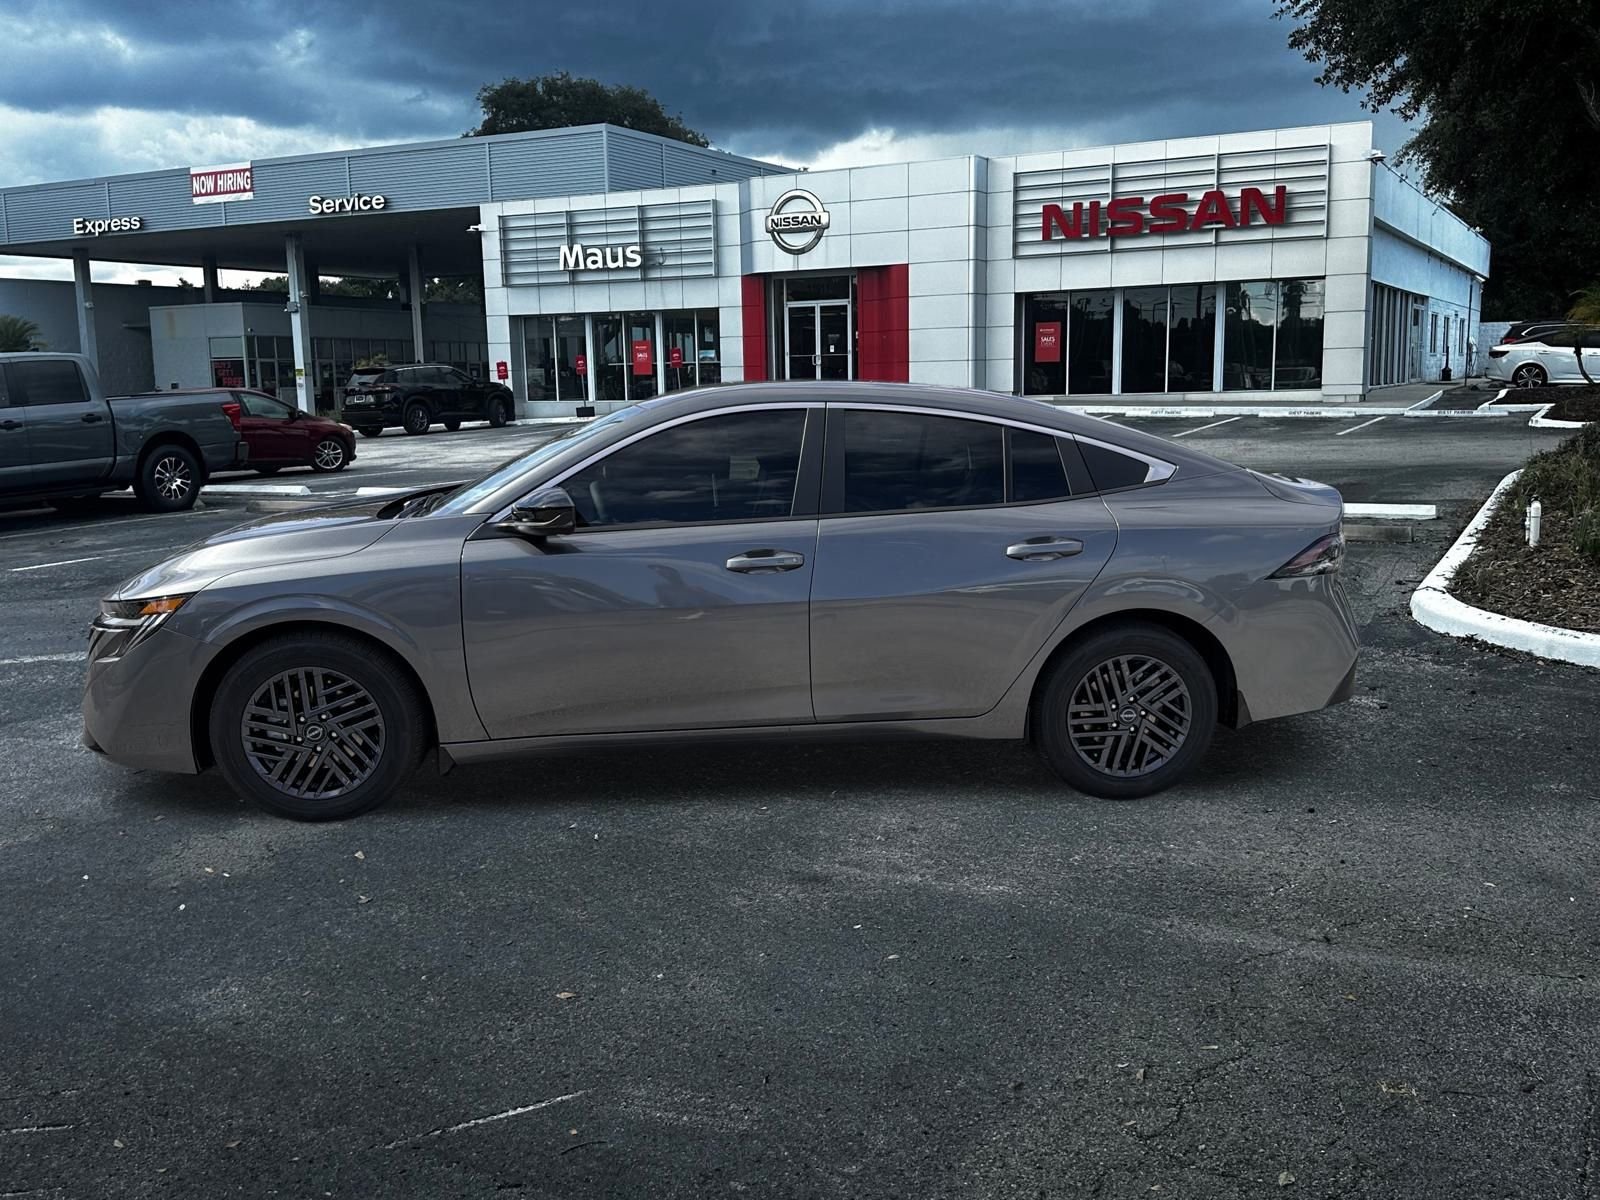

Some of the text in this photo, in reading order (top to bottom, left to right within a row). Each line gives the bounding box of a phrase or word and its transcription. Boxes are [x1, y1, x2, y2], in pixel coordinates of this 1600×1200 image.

[192, 170, 252, 195] NOW HIRING
[308, 193, 386, 215] Service
[1041, 184, 1288, 241] NISSAN
[72, 215, 142, 237] Express
[769, 214, 823, 231] NISSAN
[558, 243, 643, 271] Maus
